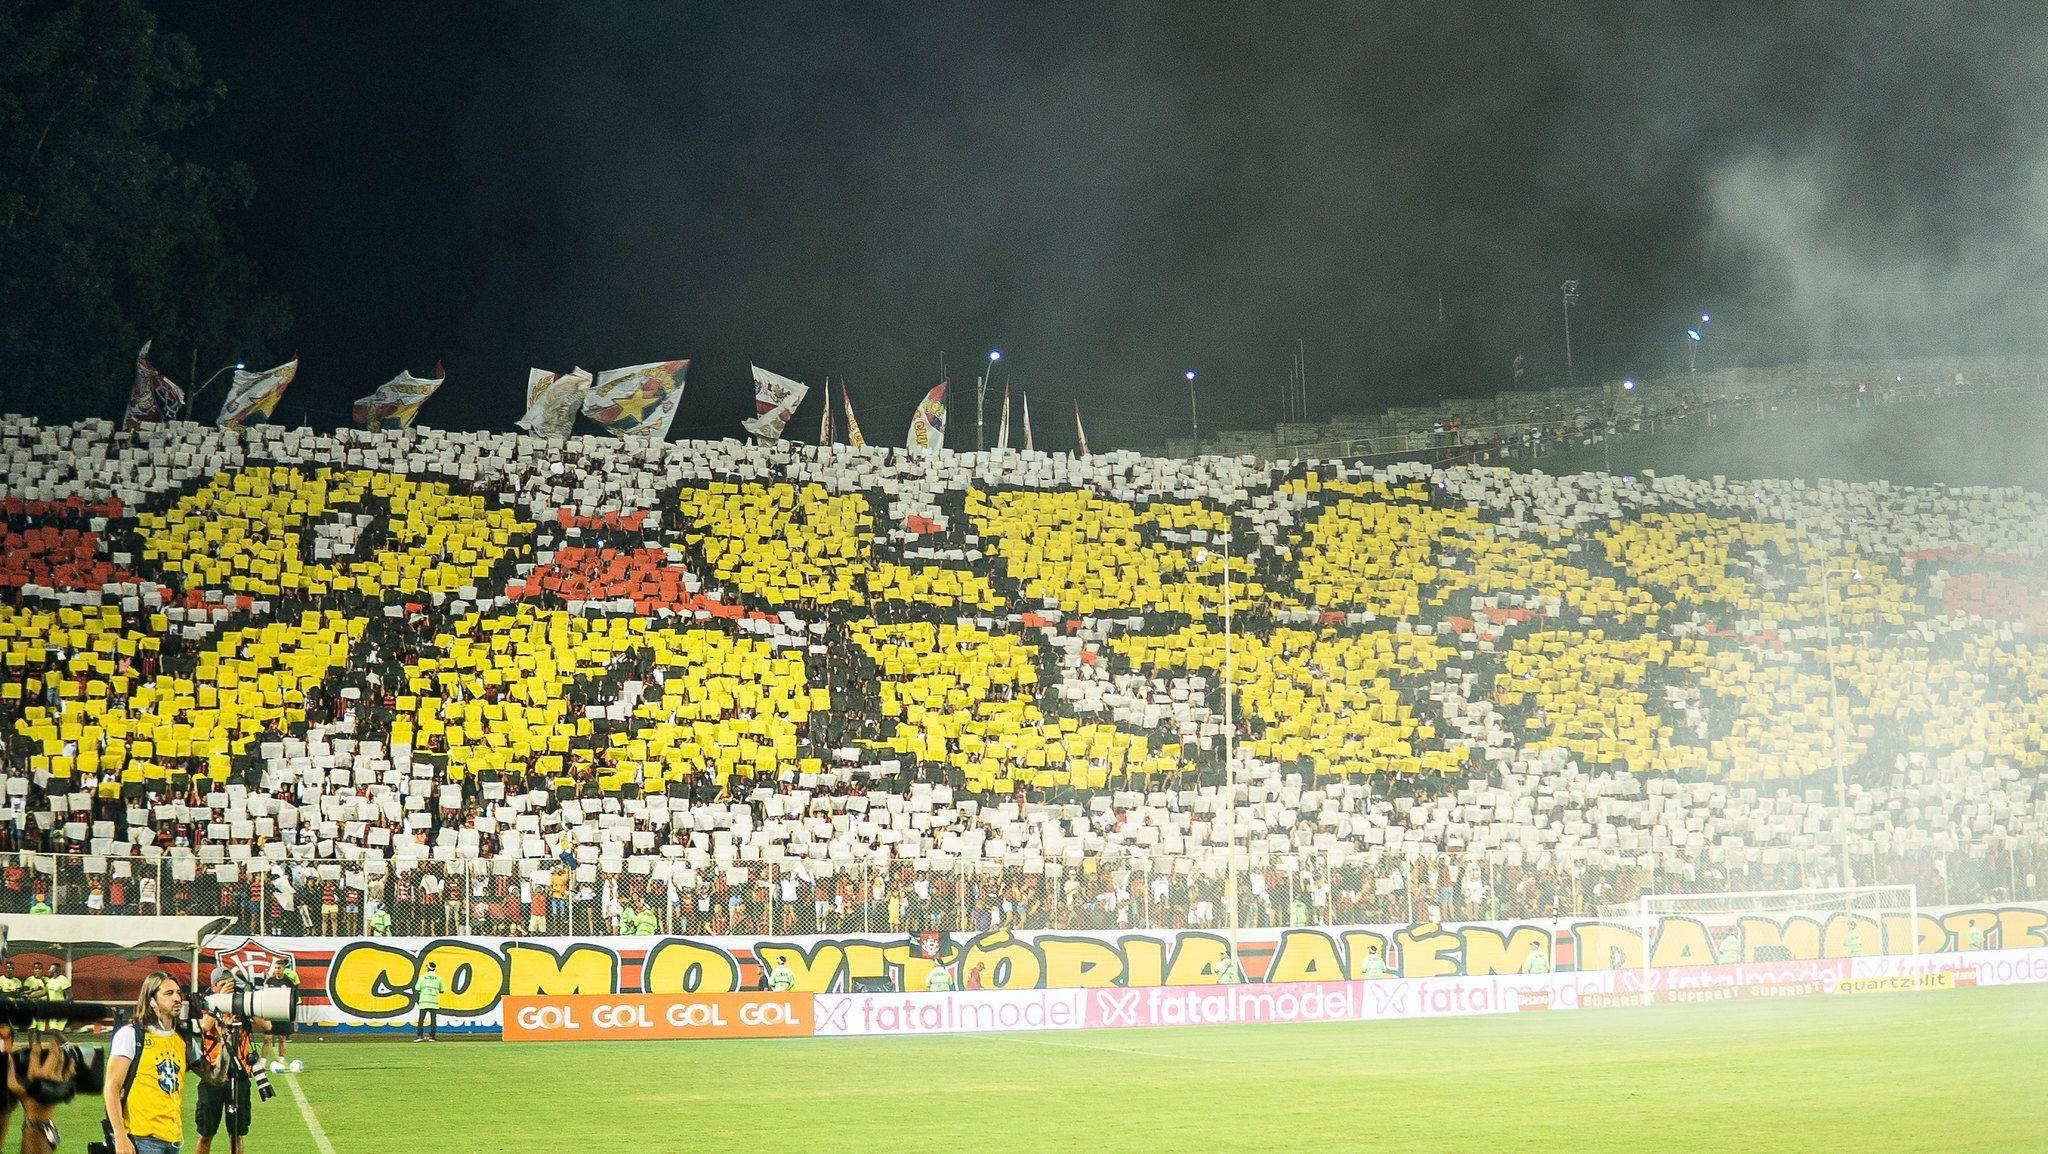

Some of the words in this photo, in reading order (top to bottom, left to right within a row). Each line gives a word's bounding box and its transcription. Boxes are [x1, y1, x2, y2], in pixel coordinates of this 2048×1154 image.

[327, 938, 619, 1018] COM
[645, 938, 740, 993] O
[754, 929, 1249, 993] VITÓRIA
[1267, 922, 1552, 982] ALÉM
[1572, 915, 1720, 971] DA
[1668, 986, 1740, 1001] SUPERBET
[1750, 980, 1821, 996] SUPERBET
[592, 1004, 654, 1028] GOL
[666, 1003, 728, 1027] GOL
[739, 1001, 800, 1026] GOL
[1147, 983, 1354, 1025] fatalmodel
[517, 1006, 579, 1029] GOL
